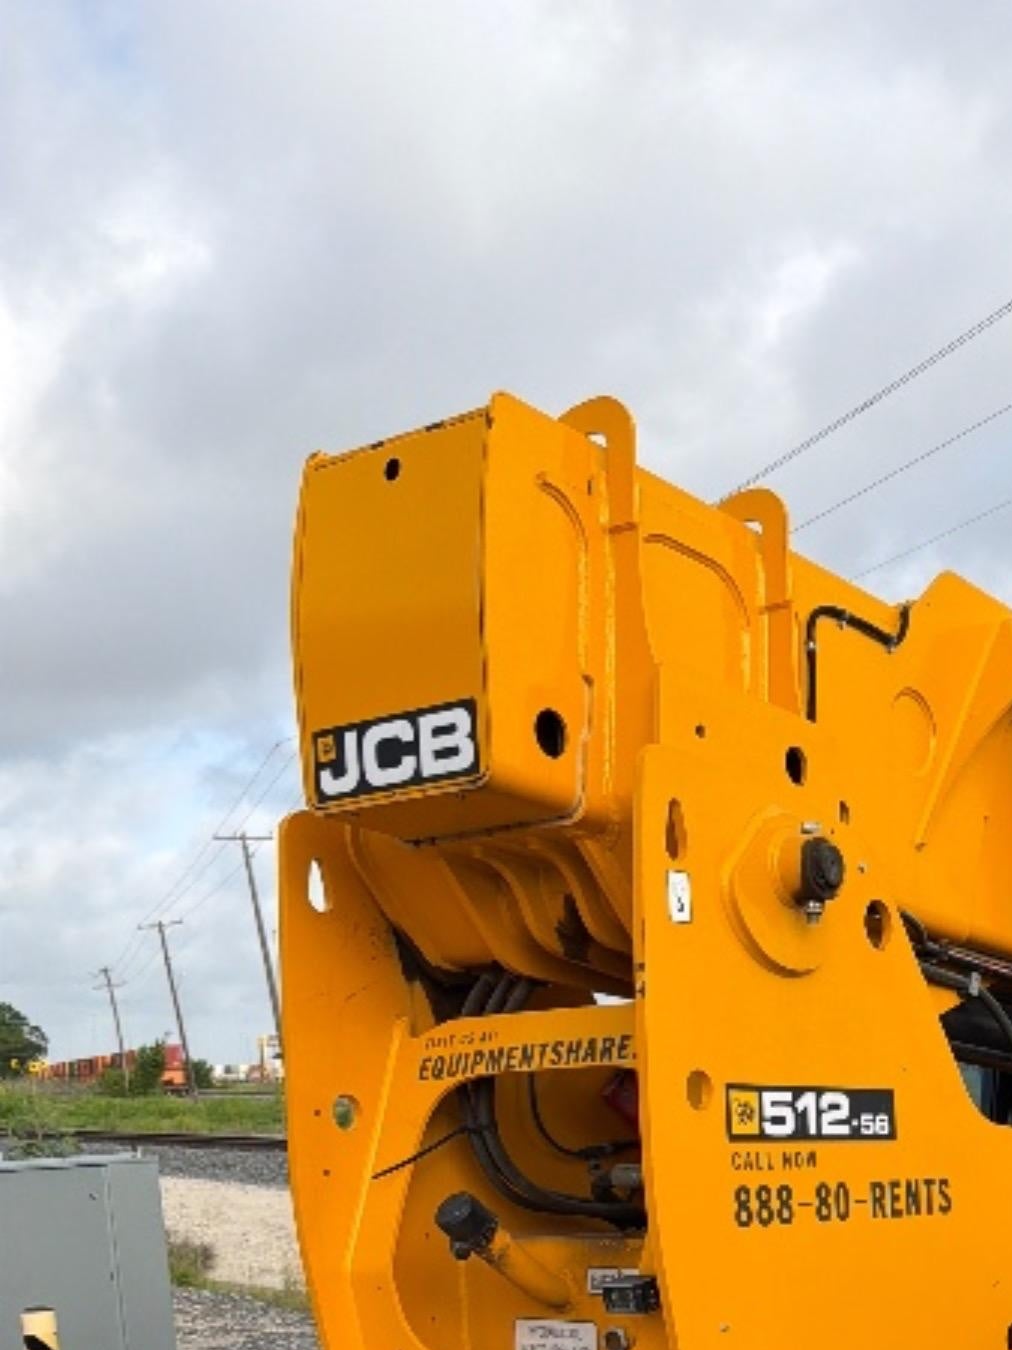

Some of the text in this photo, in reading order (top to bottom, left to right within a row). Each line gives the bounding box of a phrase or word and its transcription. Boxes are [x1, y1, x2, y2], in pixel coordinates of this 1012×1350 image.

[319, 707, 475, 796] JCB
[731, 1151, 775, 1171] CALL
[734, 1178, 952, 1228] 888-80-RENTS
